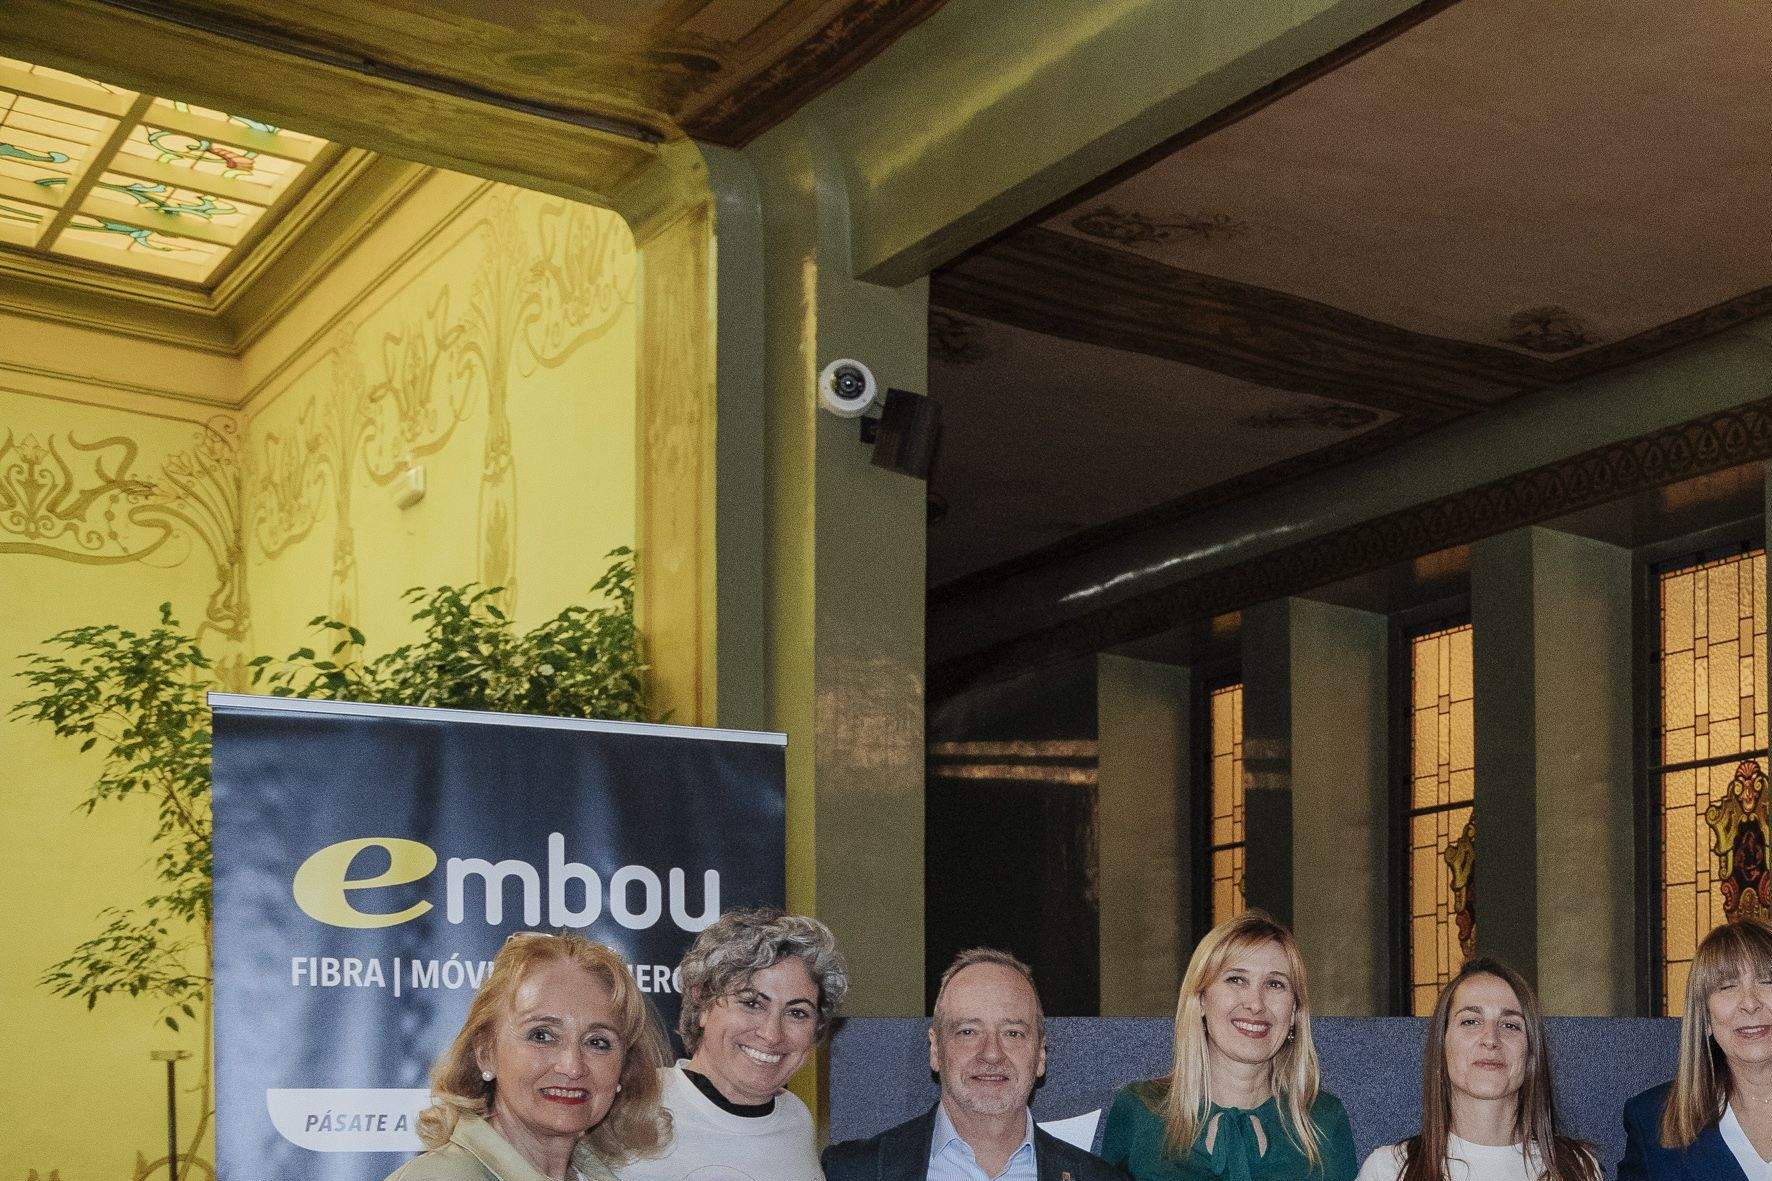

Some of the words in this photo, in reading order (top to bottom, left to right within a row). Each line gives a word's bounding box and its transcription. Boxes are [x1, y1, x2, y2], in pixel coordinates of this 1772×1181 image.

[292, 831, 720, 932] embou
[291, 956, 386, 988] FIBRA
[305, 1109, 388, 1132] PÁSATE
[394, 1114, 408, 1132] A
